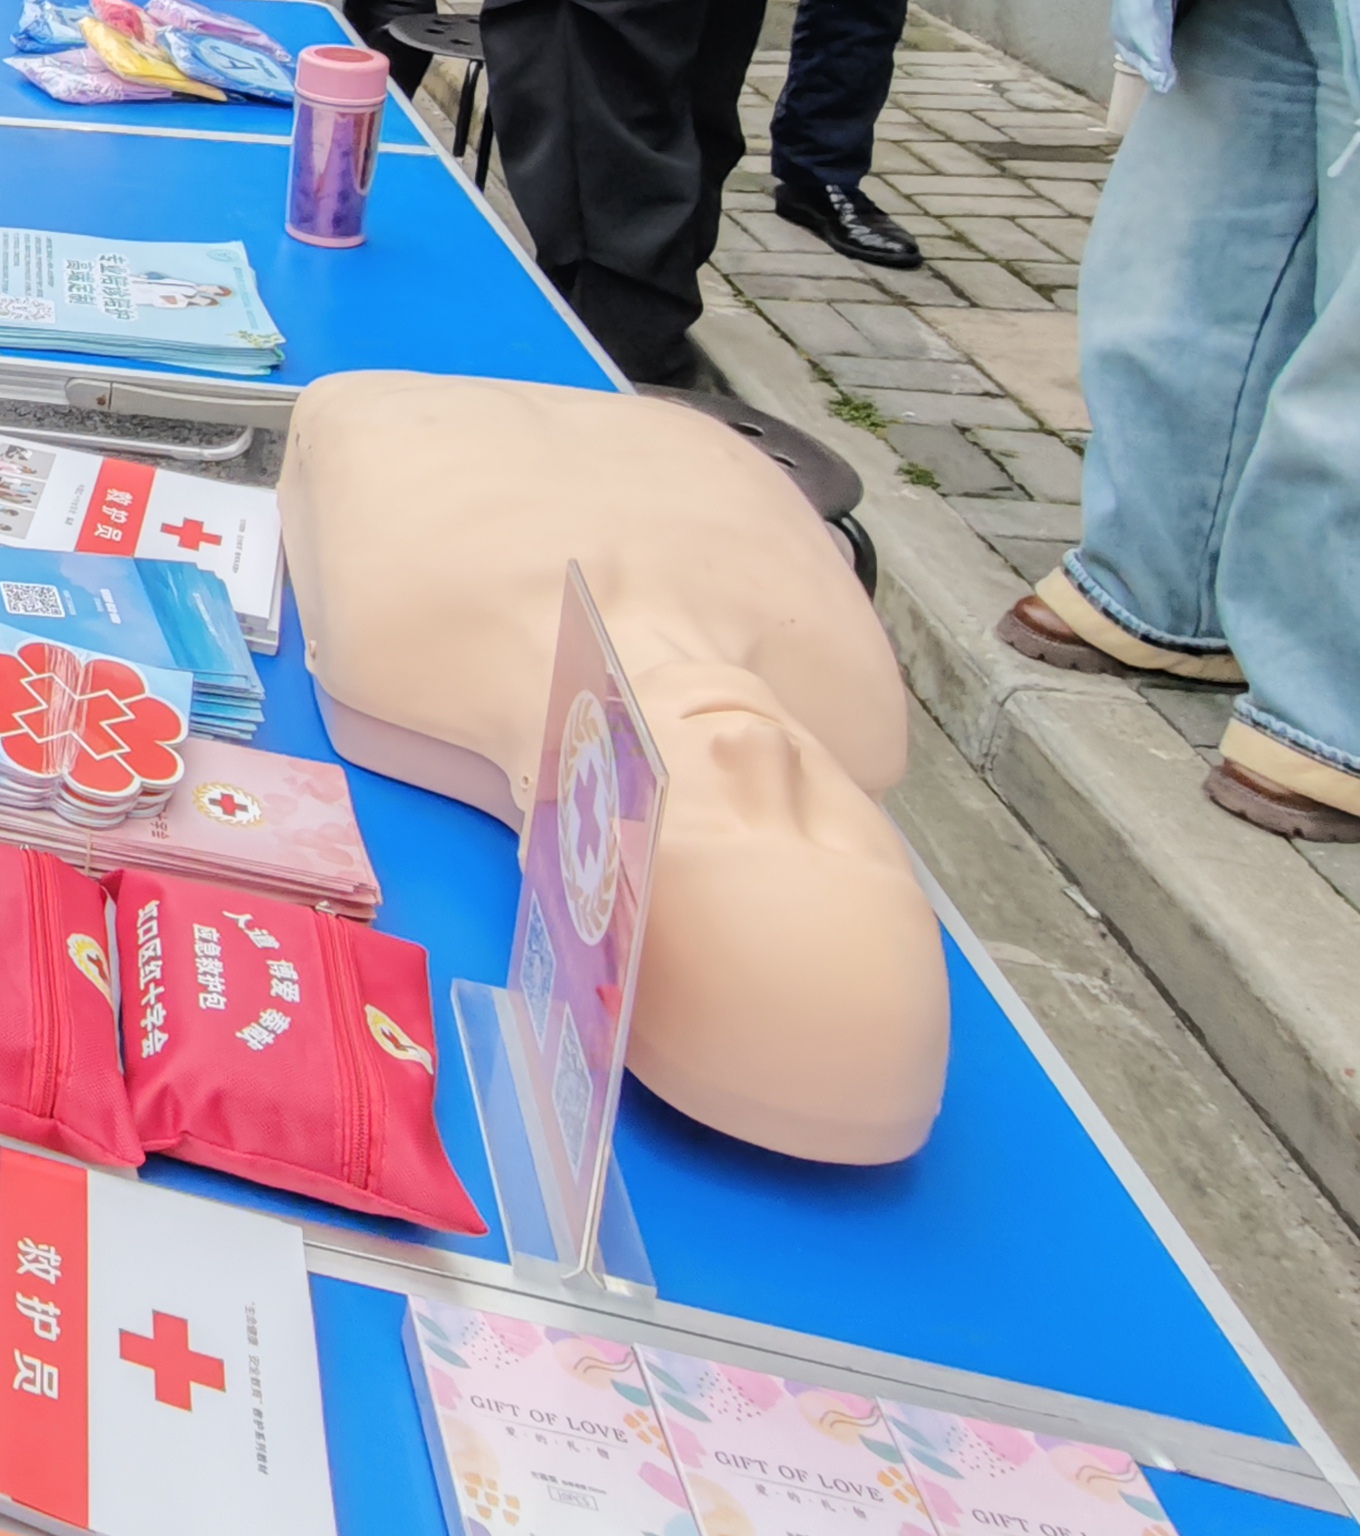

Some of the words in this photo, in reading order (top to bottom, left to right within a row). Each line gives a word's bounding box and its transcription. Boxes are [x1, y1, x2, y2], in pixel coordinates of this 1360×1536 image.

[94, 486, 134, 542] 救护员
[137, 899, 170, 1059] 虹口区红十字会
[193, 924, 228, 1010] 应急救护包
[222, 910, 280, 952] 人道
[266, 959, 301, 1004] 博爱
[11, 1236, 63, 1402] 救护员
[470, 1395, 520, 1418] GIFT
[529, 1409, 558, 1426] OF
[566, 1417, 629, 1444] LOVE
[714, 1450, 769, 1475] GIFT
[778, 1464, 809, 1483] OF
[819, 1473, 884, 1503] LOVE
[971, 1507, 1030, 1533] GIFT
